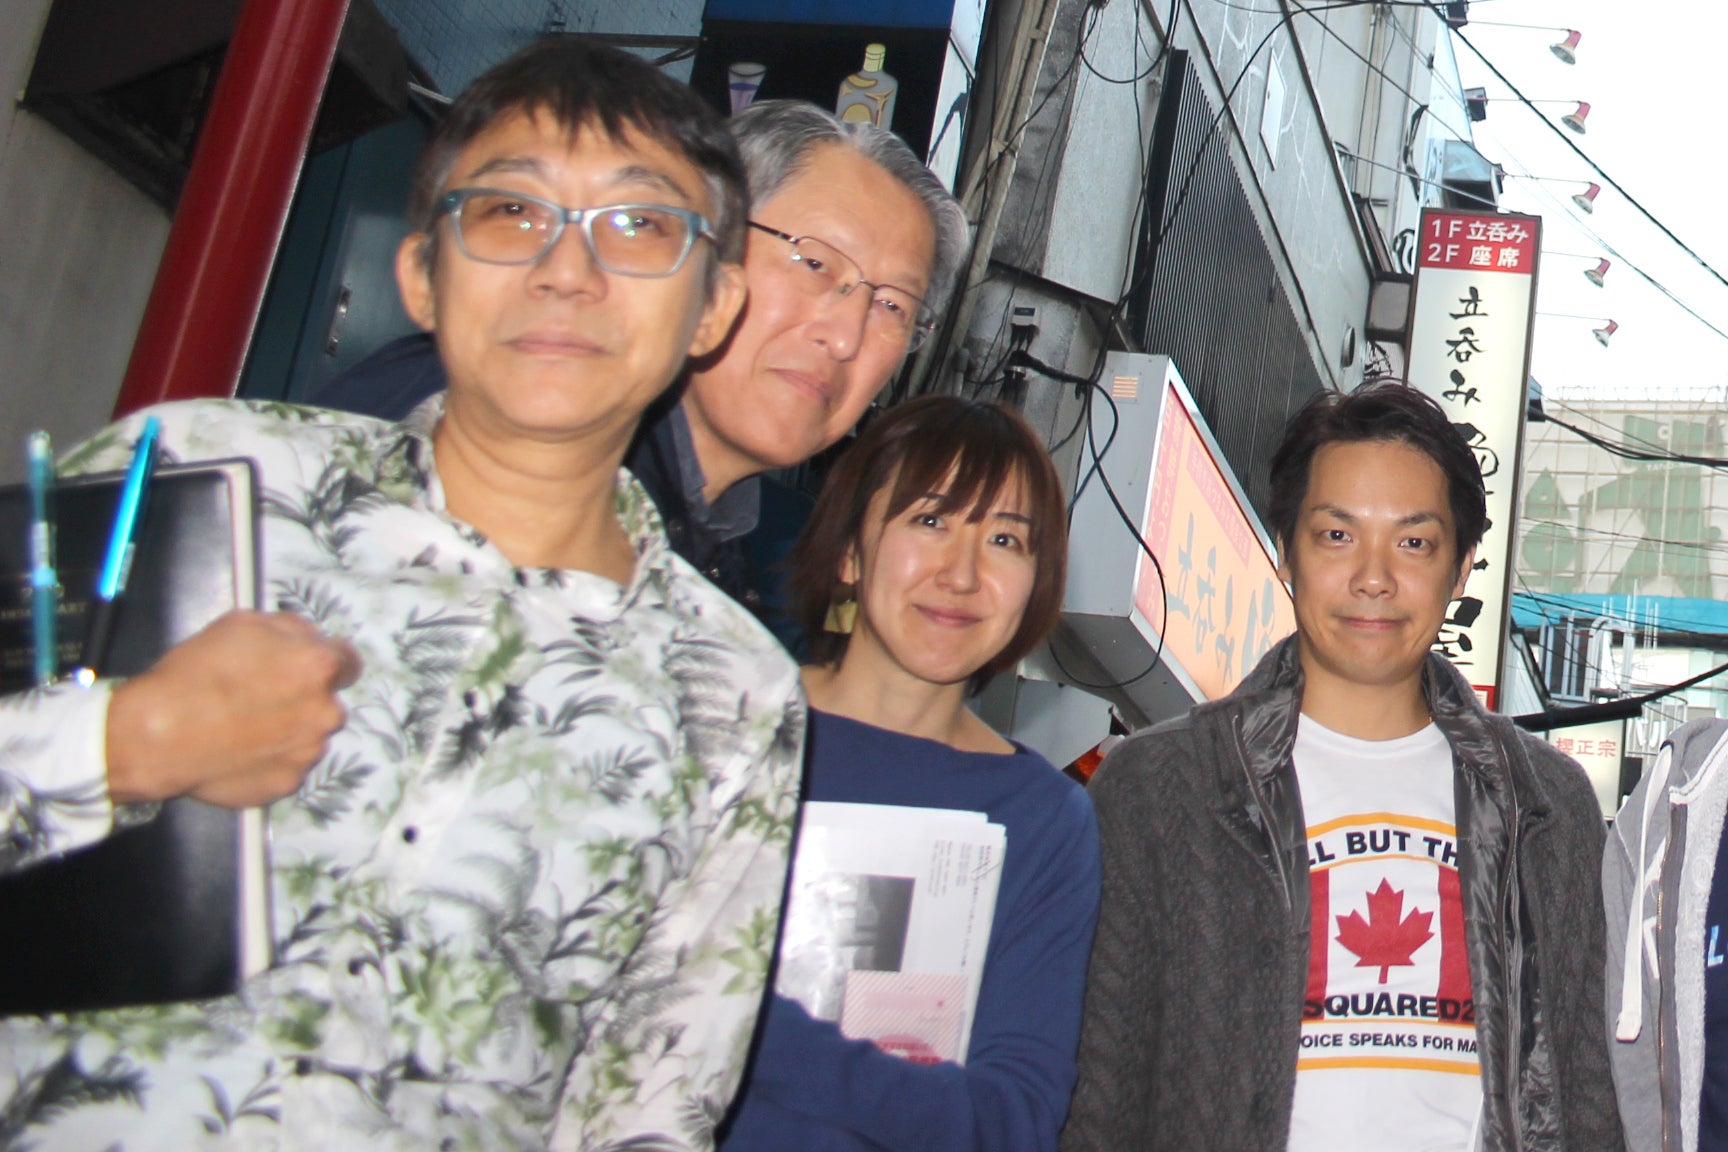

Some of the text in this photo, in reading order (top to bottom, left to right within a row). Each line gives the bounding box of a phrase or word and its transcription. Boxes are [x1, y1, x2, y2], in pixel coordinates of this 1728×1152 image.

[1431, 218, 1529, 243] 1F 立呑み
[1428, 243, 1460, 262] 2F
[1345, 829, 1411, 856] BUT
[1348, 1033, 1418, 1048] SPEAKS
[1423, 1034, 1454, 1051] FOR
